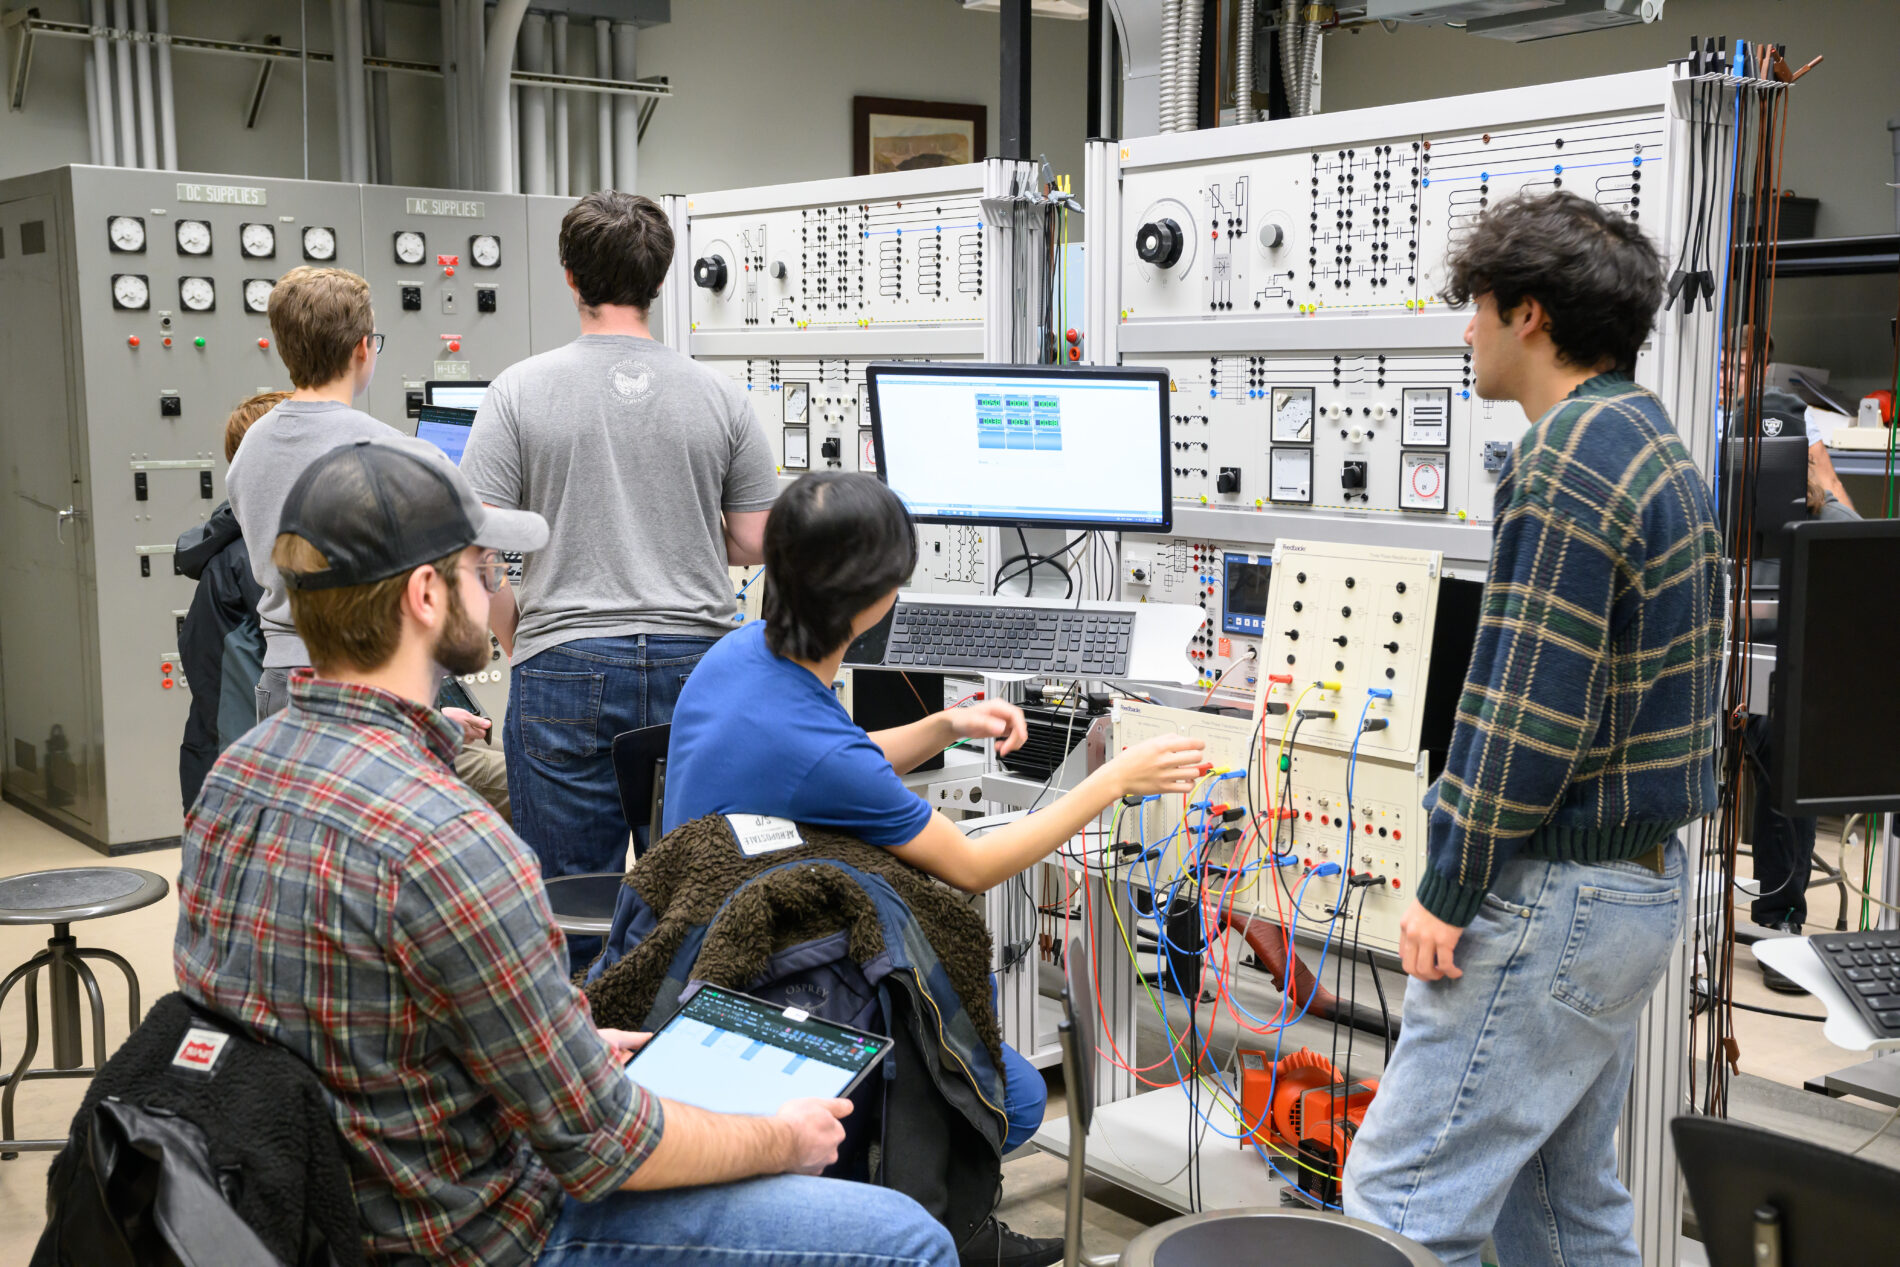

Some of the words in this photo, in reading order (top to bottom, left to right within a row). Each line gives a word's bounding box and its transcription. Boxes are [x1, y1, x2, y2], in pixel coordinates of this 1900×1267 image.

[186, 185, 201, 201] DC
[206, 186, 259, 205] SUPPLIES
[415, 199, 428, 214] AC
[432, 200, 477, 217] SUPPLIES
[785, 983, 830, 998] OSPREY
